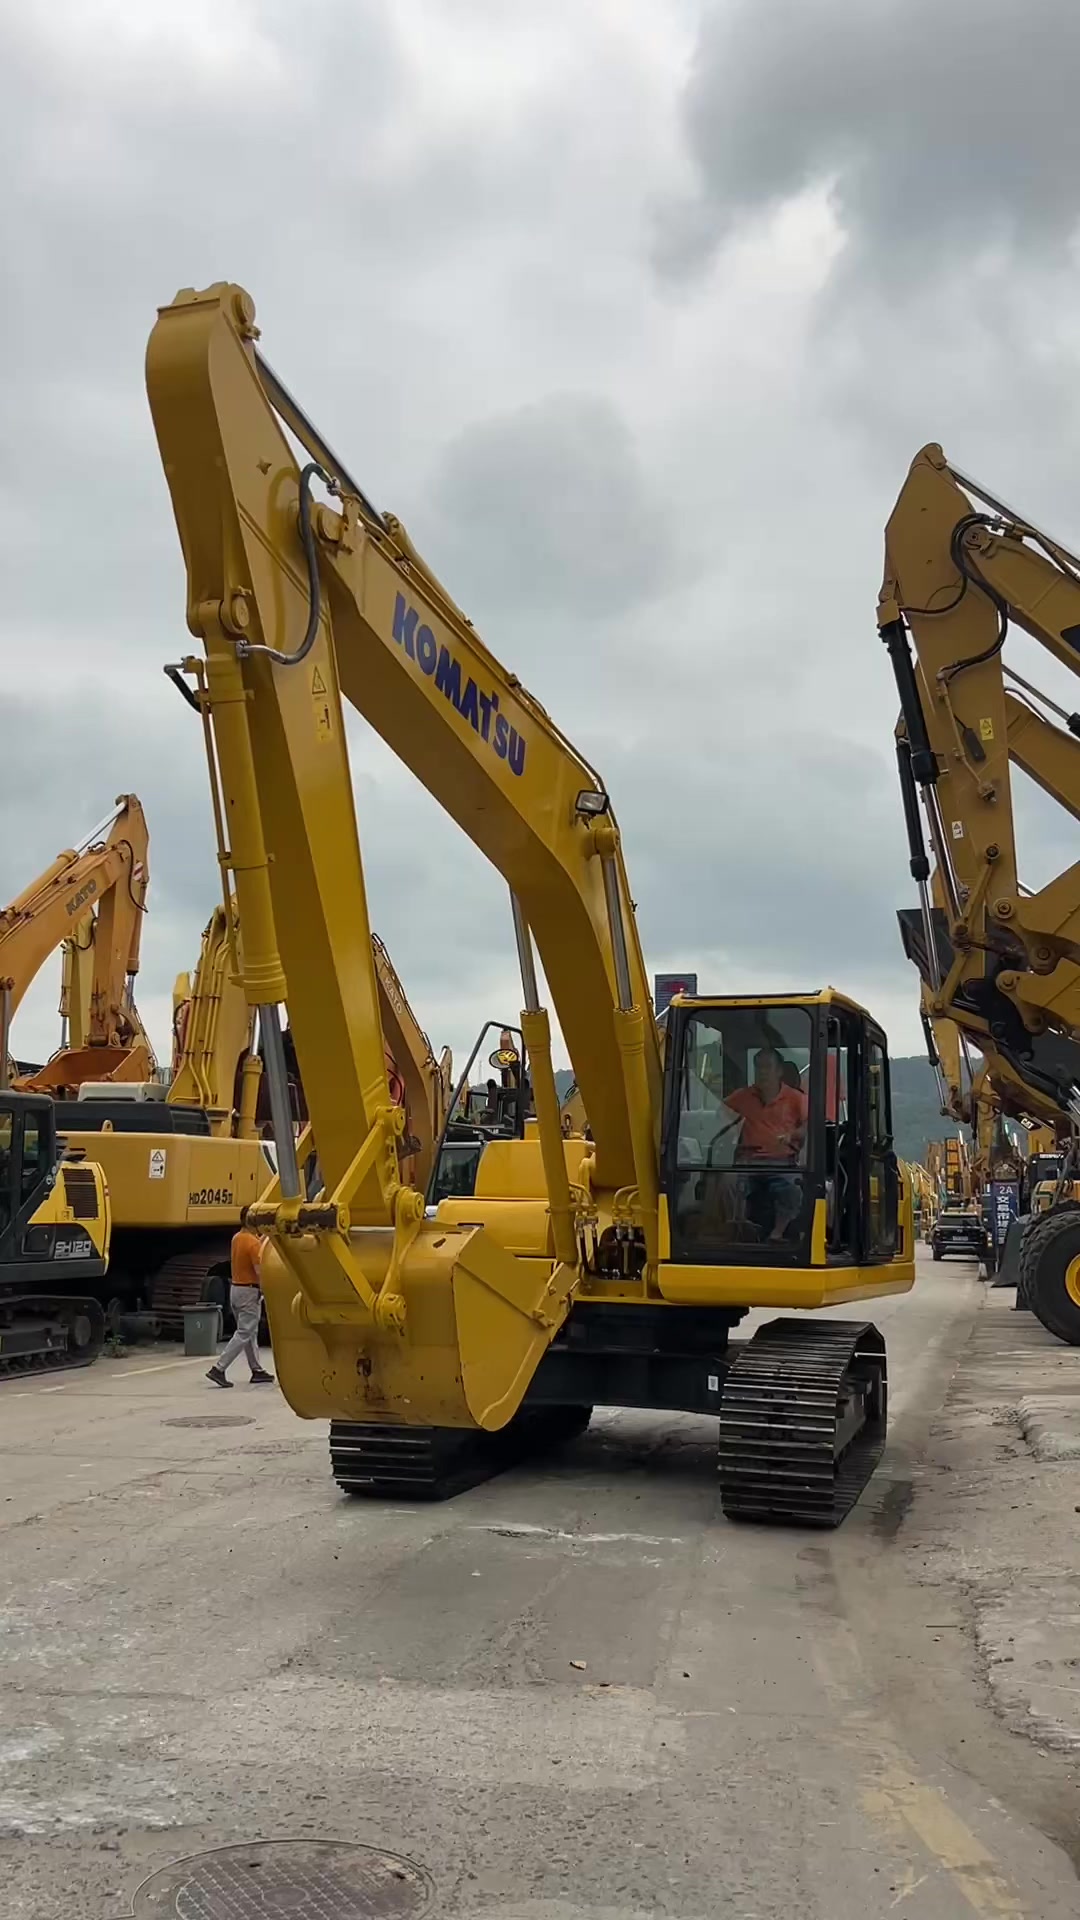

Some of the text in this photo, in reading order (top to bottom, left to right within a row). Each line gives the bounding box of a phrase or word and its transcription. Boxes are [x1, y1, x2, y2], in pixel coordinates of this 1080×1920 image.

[392, 590, 527, 777] KOMATSU
[66, 878, 97, 916] KATO
[999, 1185, 1014, 1195] 2A
[55, 1240, 92, 1254] SH120
